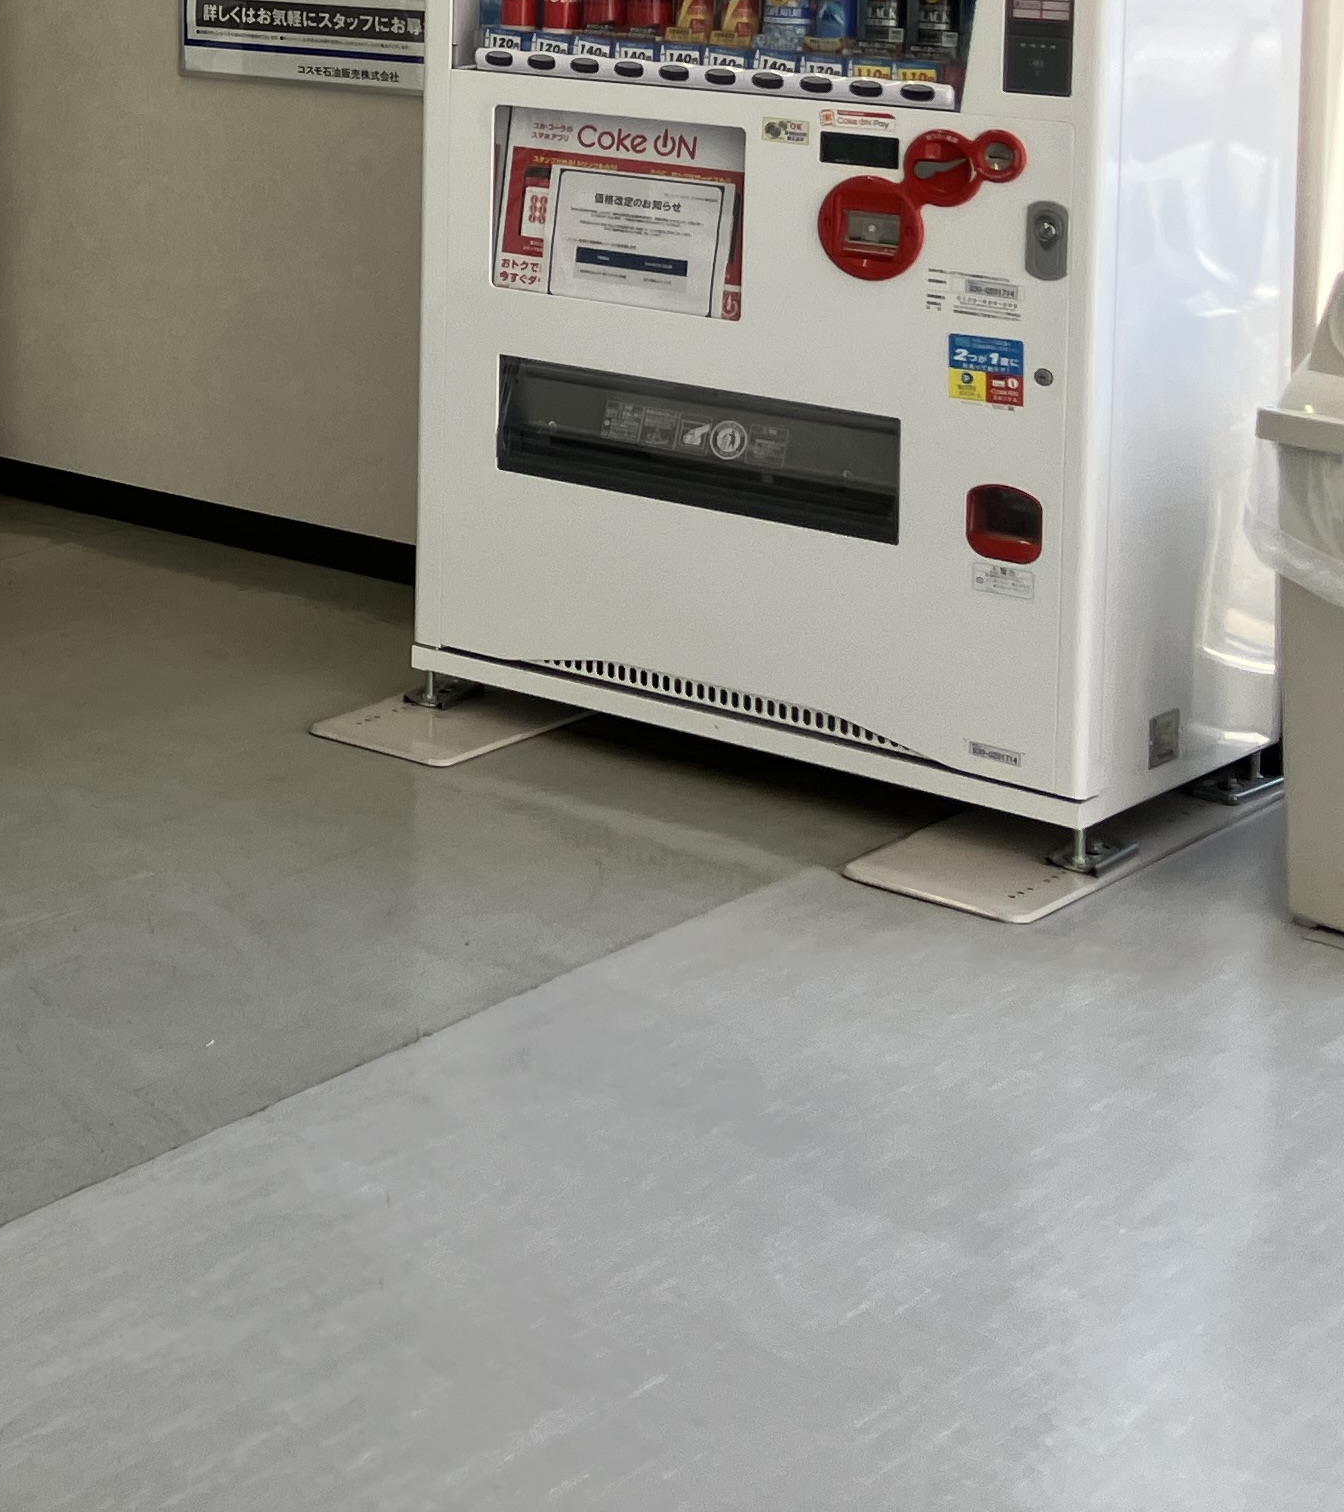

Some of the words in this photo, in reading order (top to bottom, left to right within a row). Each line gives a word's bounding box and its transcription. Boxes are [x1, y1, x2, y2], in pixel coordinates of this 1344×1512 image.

[297, 64, 401, 84] コスモ石油販売株式会社
[577, 124, 648, 155] Coke
[653, 128, 699, 161] ON
[594, 192, 682, 214] 価格改定のお知らせ
[500, 258, 539, 272] おトクで
[499, 271, 541, 286] 今すぐダ
